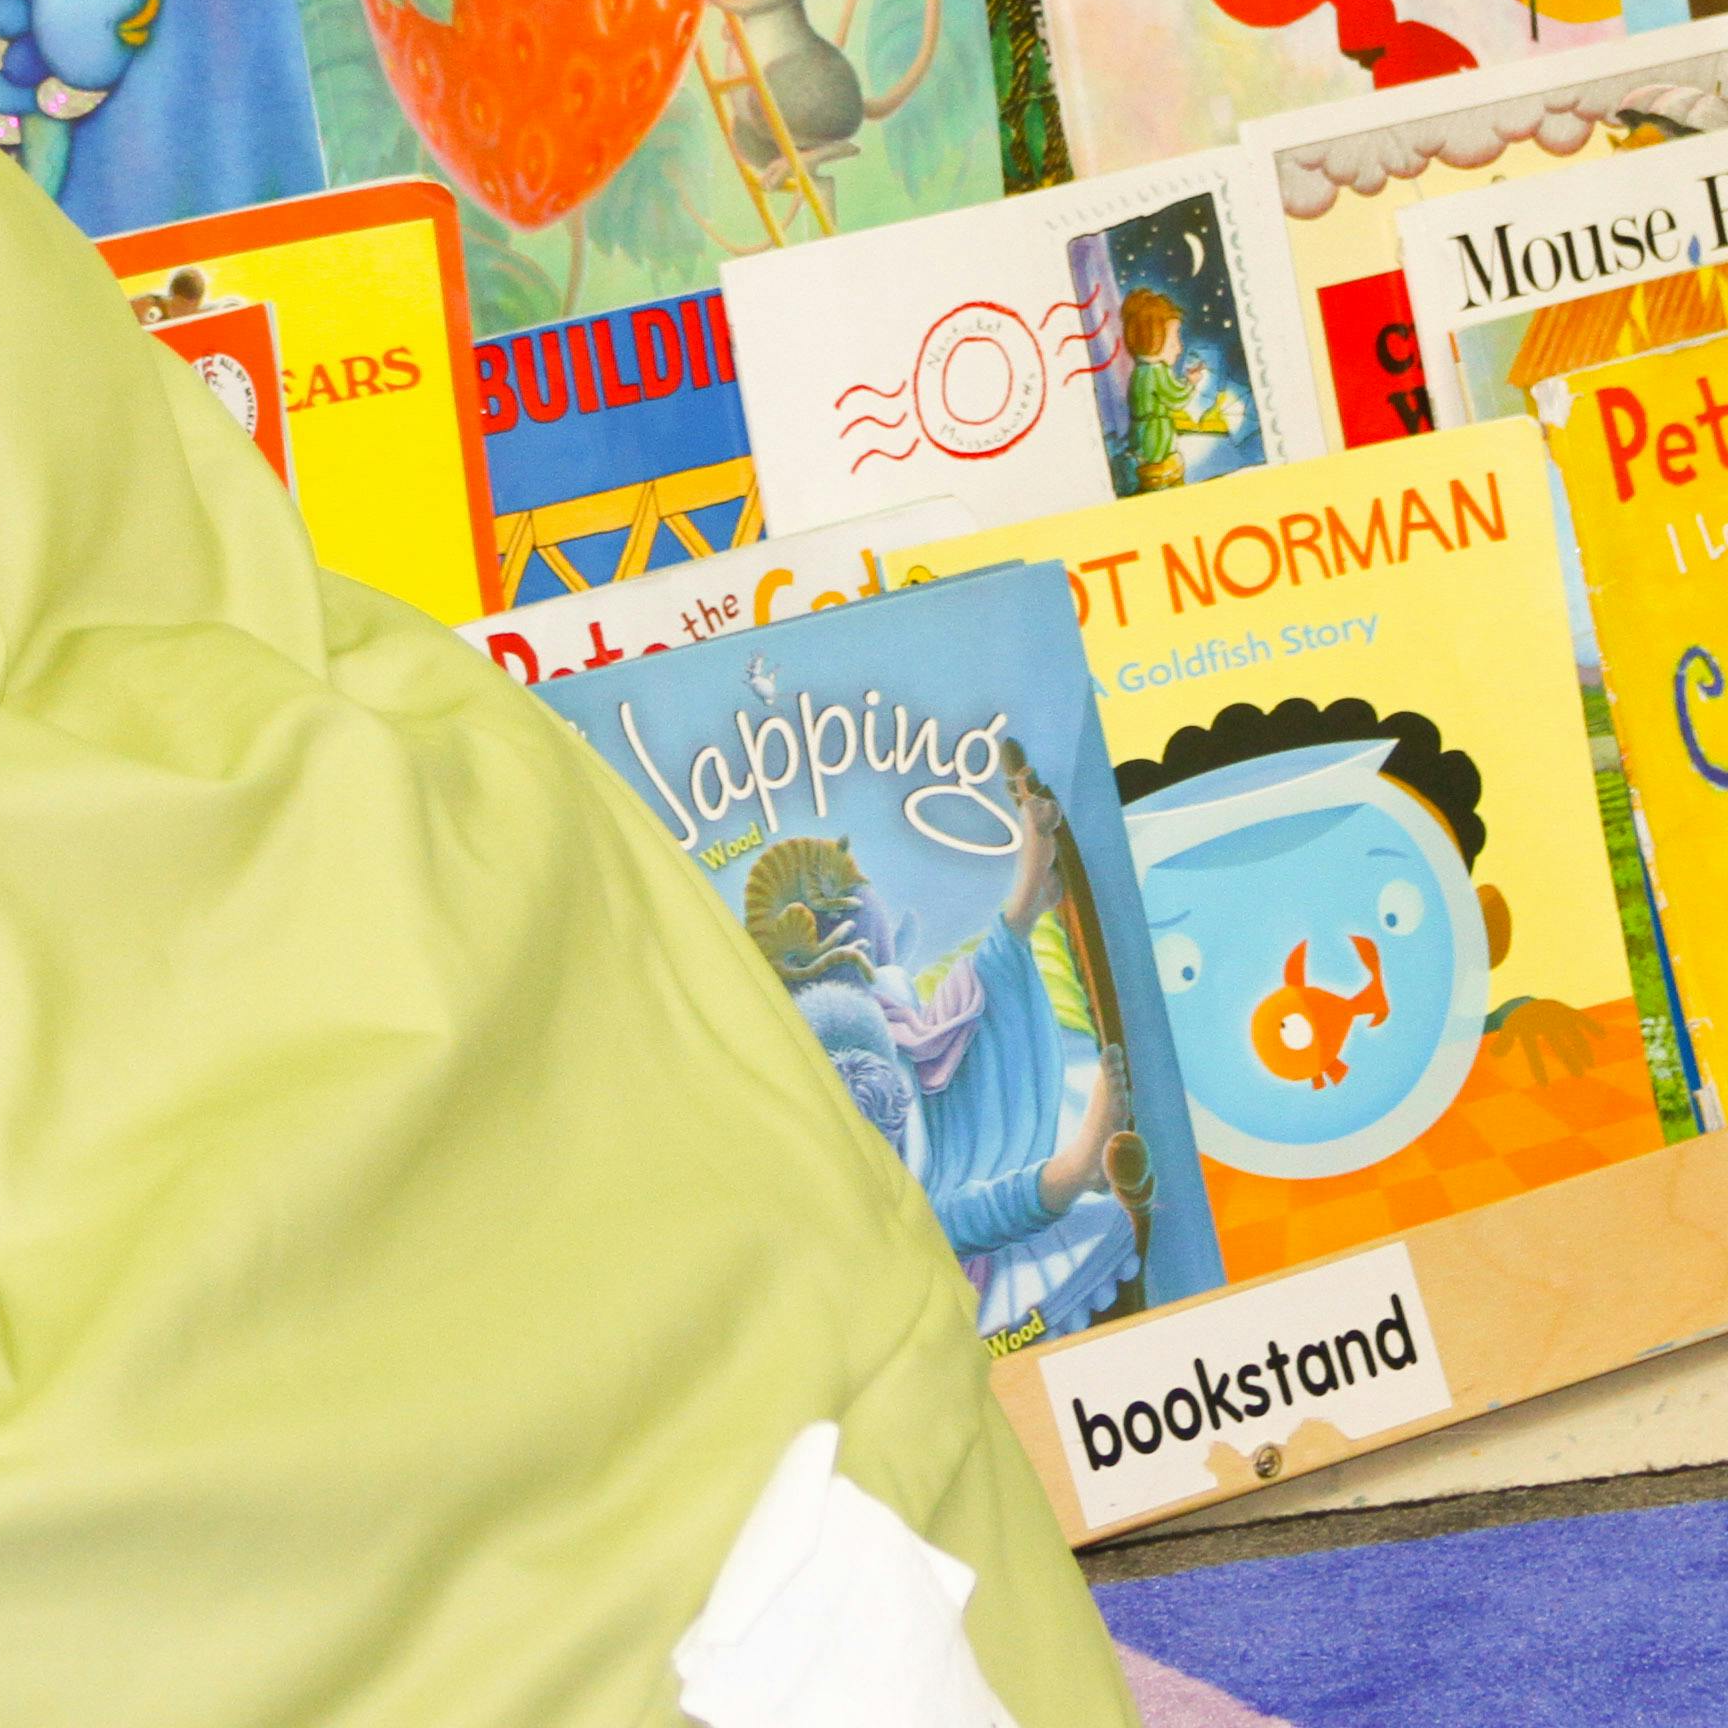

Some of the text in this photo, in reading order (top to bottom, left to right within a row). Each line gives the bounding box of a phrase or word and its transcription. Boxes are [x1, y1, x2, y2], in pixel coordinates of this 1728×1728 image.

[1447, 205, 1676, 311] Mouse
[1161, 472, 1508, 614] NORMAN
[1666, 522, 1688, 574] I
[681, 593, 740, 642] the
[1117, 629, 1272, 694] Goldfish
[1280, 613, 1380, 658] Story
[698, 821, 764, 872] Wood
[983, 1308, 1046, 1360] Wood
[1073, 1293, 1418, 1471] bookstand
